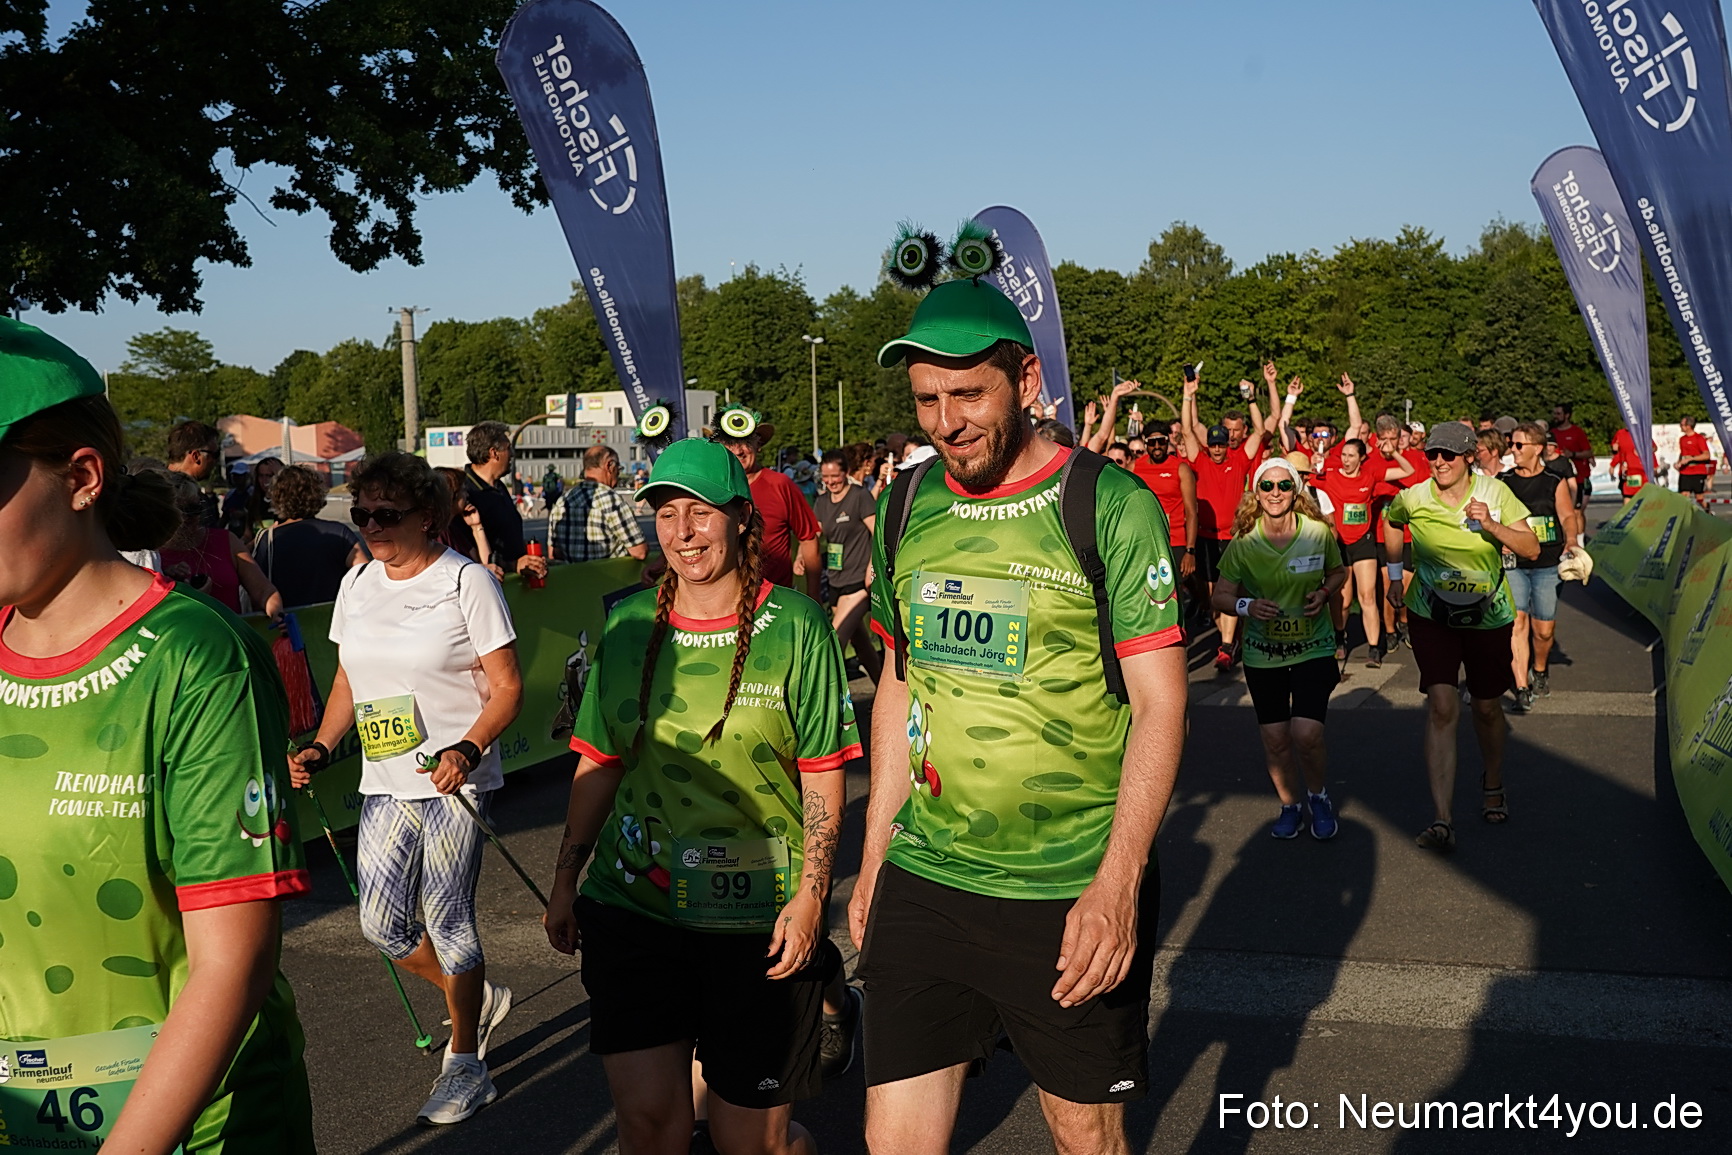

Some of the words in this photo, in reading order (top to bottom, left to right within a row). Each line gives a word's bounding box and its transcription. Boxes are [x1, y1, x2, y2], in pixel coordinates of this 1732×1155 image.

[1007, 562, 1088, 589] TRENDHAUS
[939, 592, 974, 601] Firmenlauf
[671, 610, 777, 648] MONSTERARK
[767, 601, 783, 610] !
[915, 615, 925, 649] RUN
[936, 607, 994, 645] 100
[1273, 620, 1299, 632] 201
[922, 640, 977, 657] Schabdach
[979, 648, 1006, 663] Jörg
[1005, 621, 1020, 667] 2022
[737, 682, 784, 698] ENDHA
[364, 717, 404, 742] 1976
[404, 718, 418, 743] 2022
[367, 742, 381, 751] Braun
[382, 737, 408, 748] Irmgard
[702, 857, 740, 865] Firmenlauf
[677, 879, 688, 909] RUN
[710, 872, 752, 900] 99
[687, 901, 733, 910] Schabdach
[735, 900, 775, 909] Franziska
[13, 1063, 73, 1078] Firmenlauf
[36, 1073, 73, 1084] neumarkt
[36, 1086, 104, 1133] 46
[10, 1134, 87, 1150] Schabdach
